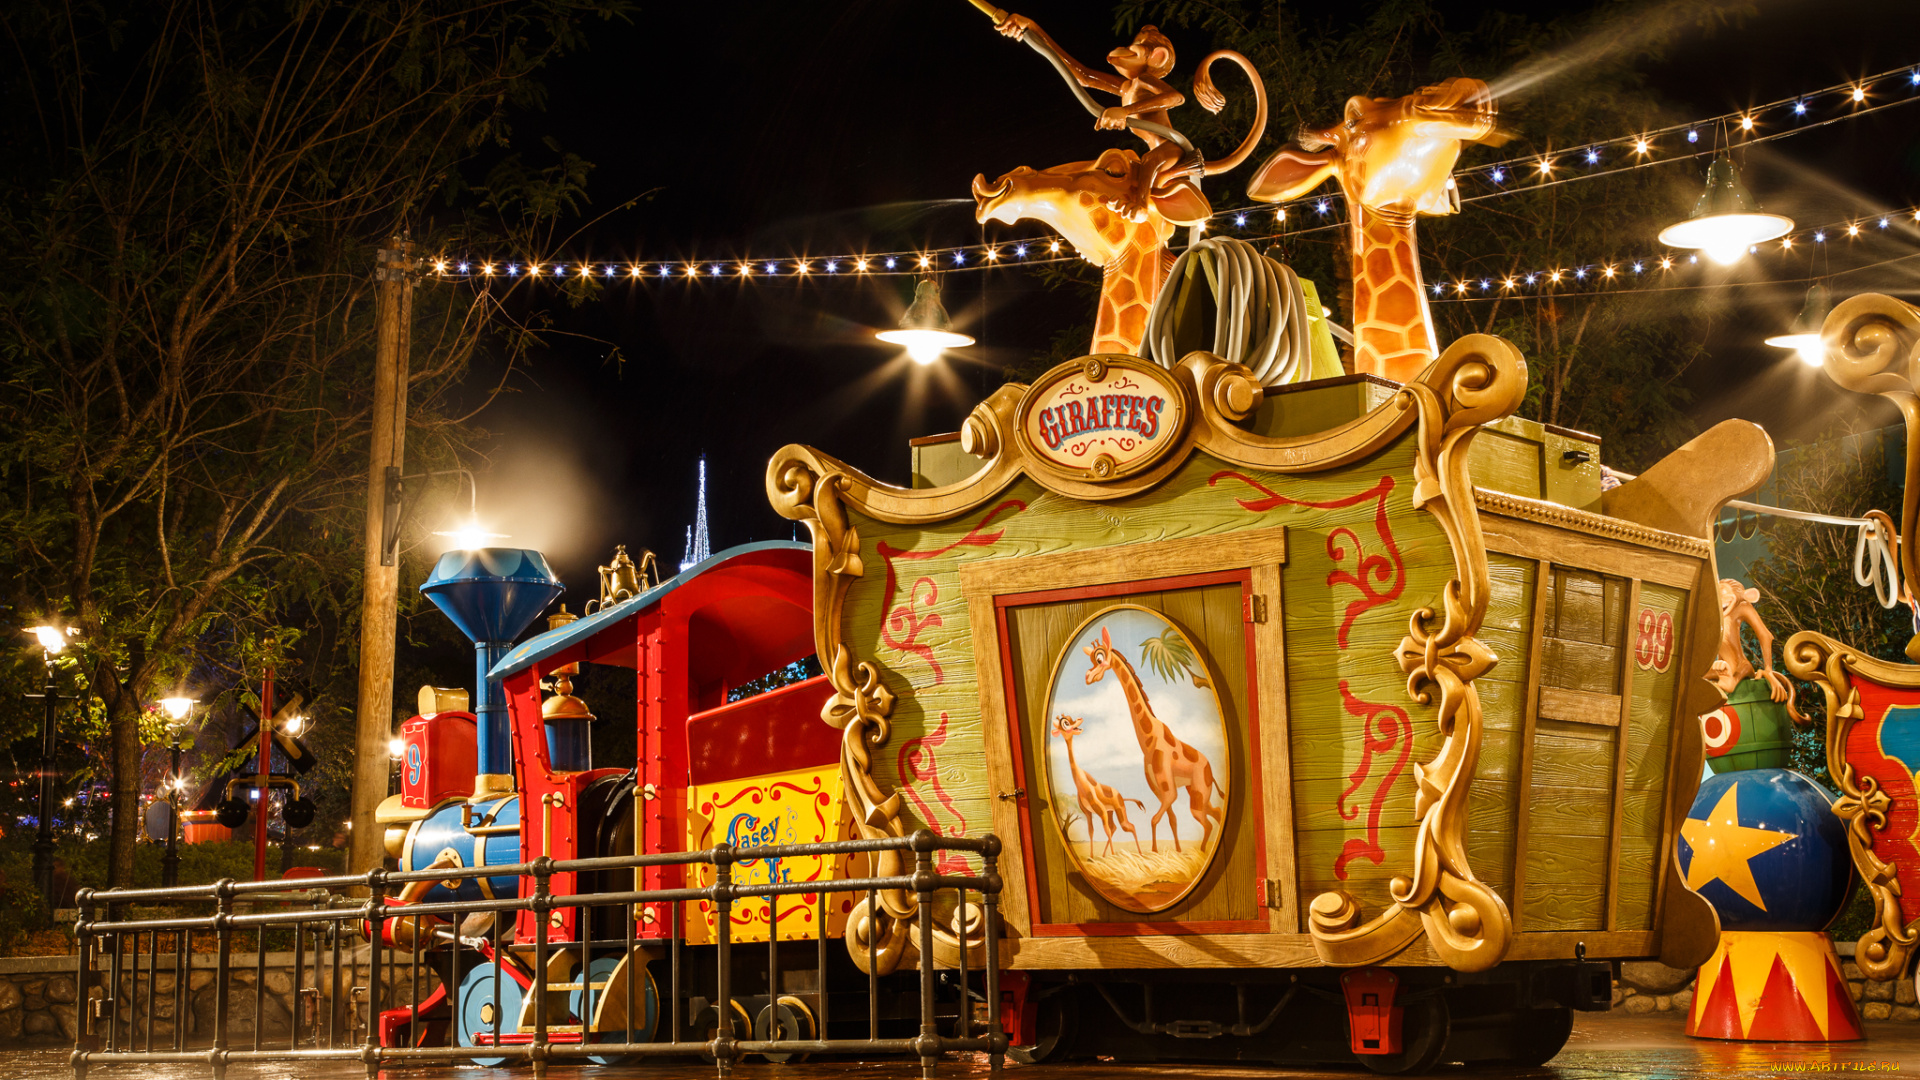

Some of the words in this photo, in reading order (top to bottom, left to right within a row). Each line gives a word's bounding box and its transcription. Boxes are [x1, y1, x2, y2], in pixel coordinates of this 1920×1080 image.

[1039, 394, 1165, 450] GIRAFFES
[1636, 608, 1674, 673] 89
[408, 743, 422, 786] 9
[726, 812, 780, 867] Casey
